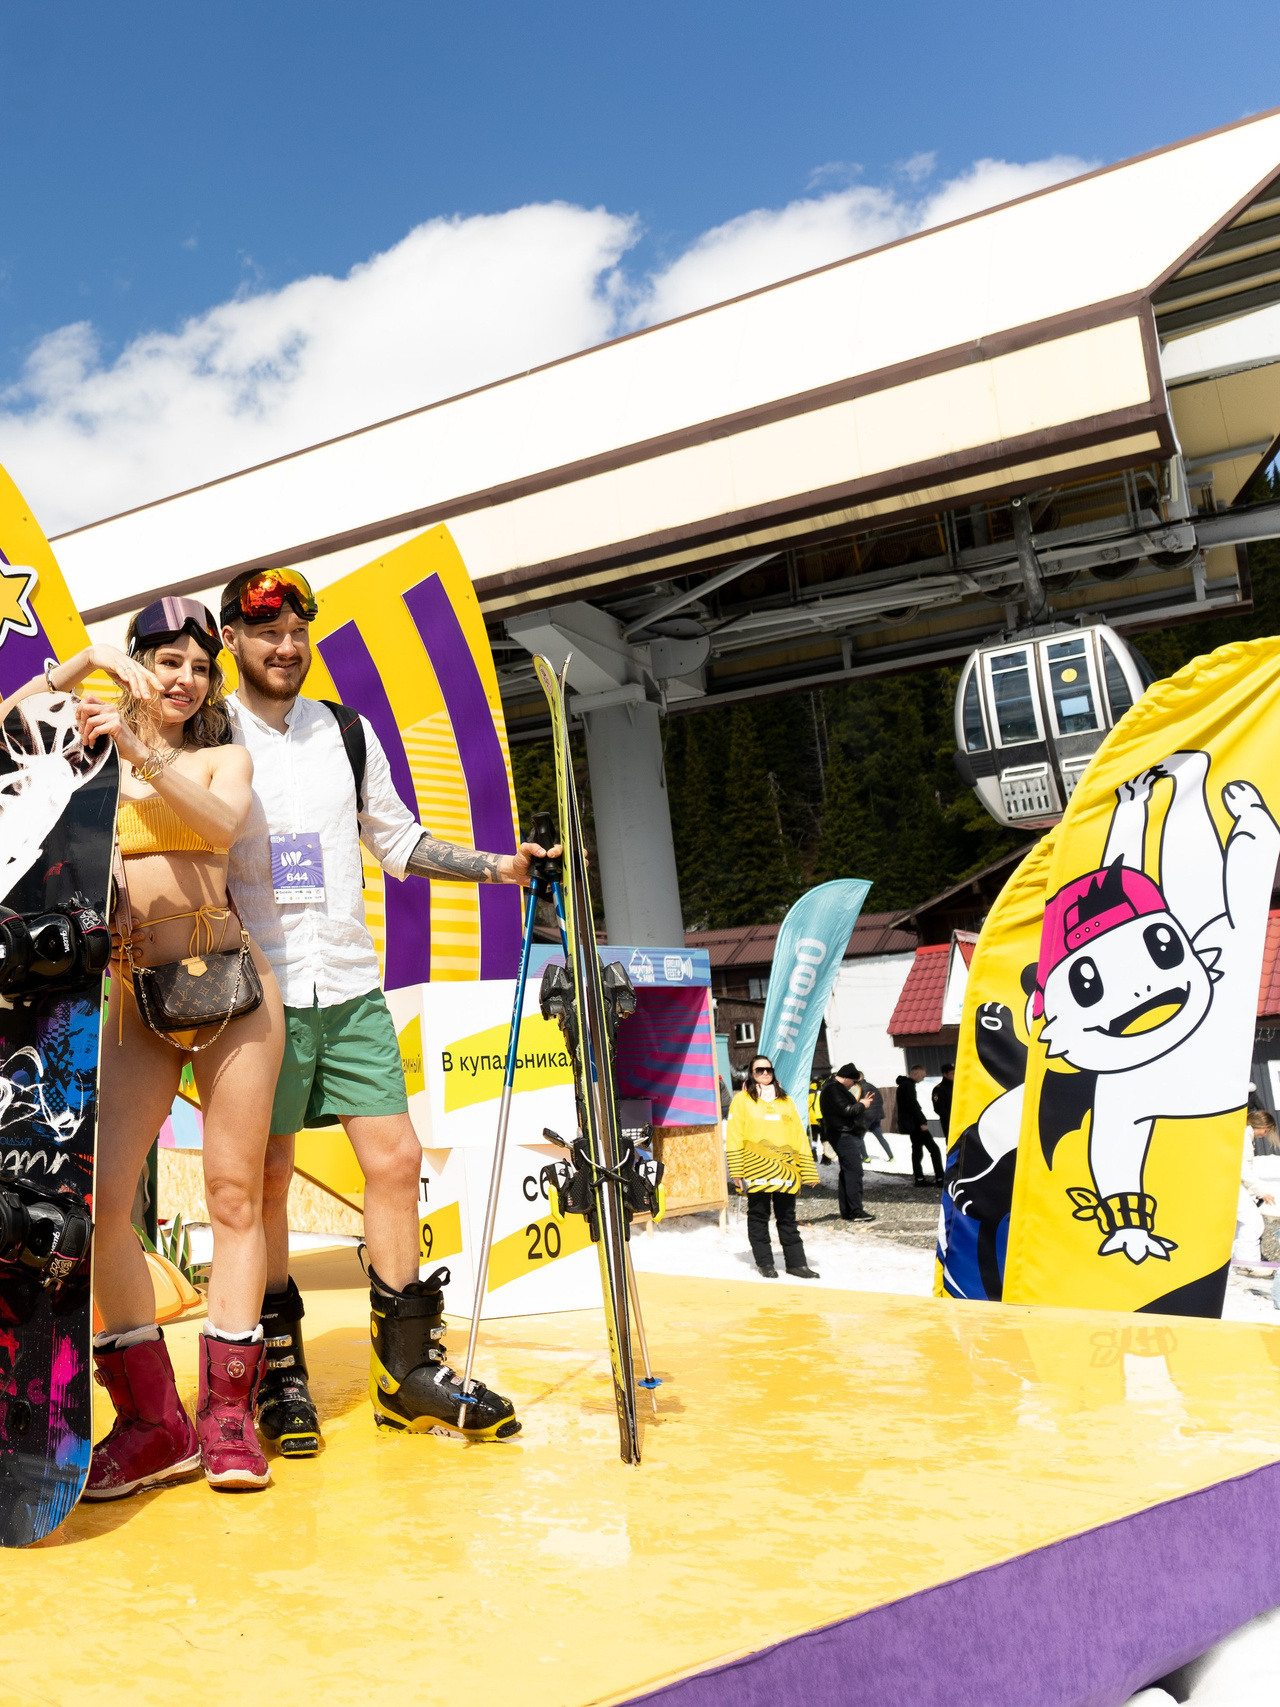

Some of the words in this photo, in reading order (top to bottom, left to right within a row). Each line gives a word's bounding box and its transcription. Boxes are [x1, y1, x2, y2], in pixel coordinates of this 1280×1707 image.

[286, 872, 308, 882] 644
[441, 1051, 454, 1072] В
[459, 1051, 575, 1077] купаьника
[418, 1177, 430, 1203] т
[419, 1223, 433, 1259] 9
[525, 1221, 561, 1260] 20
